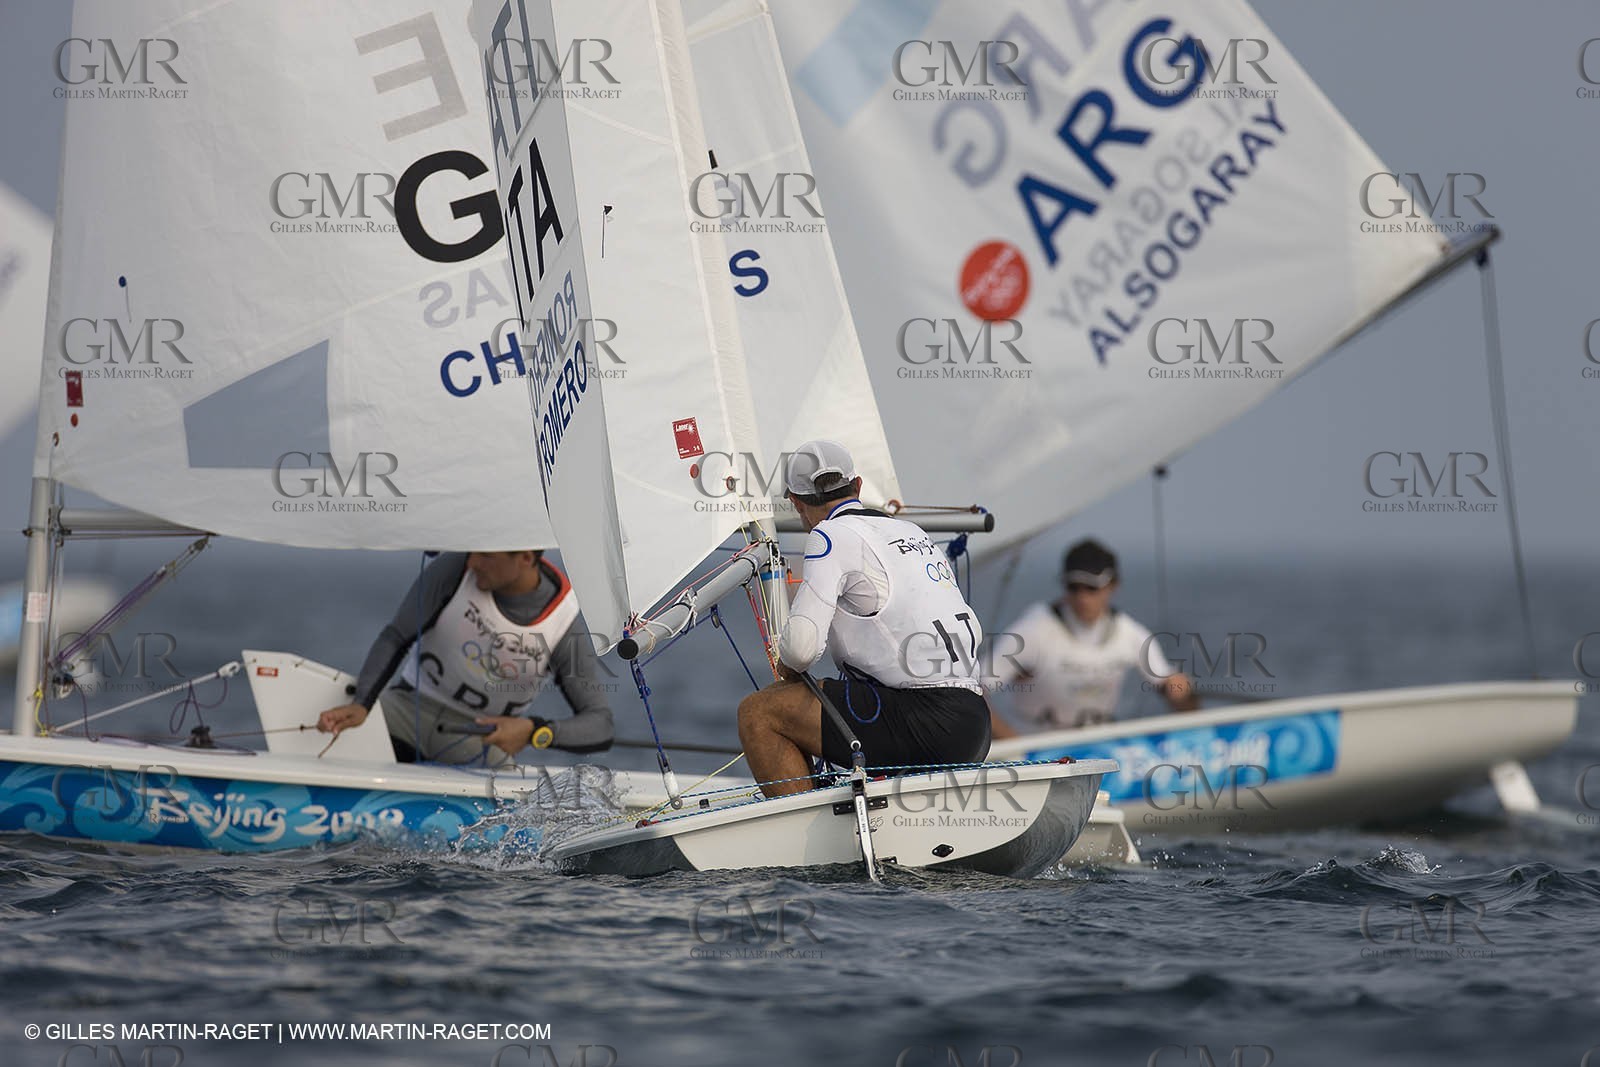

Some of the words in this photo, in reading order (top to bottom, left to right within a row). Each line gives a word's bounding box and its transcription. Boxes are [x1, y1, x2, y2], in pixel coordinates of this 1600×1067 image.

[504, 137, 564, 332] ITA
[1015, 17, 1214, 268] ARG
[1088, 100, 1287, 366] ALSOGARAY
[539, 341, 587, 487] ROMERO
